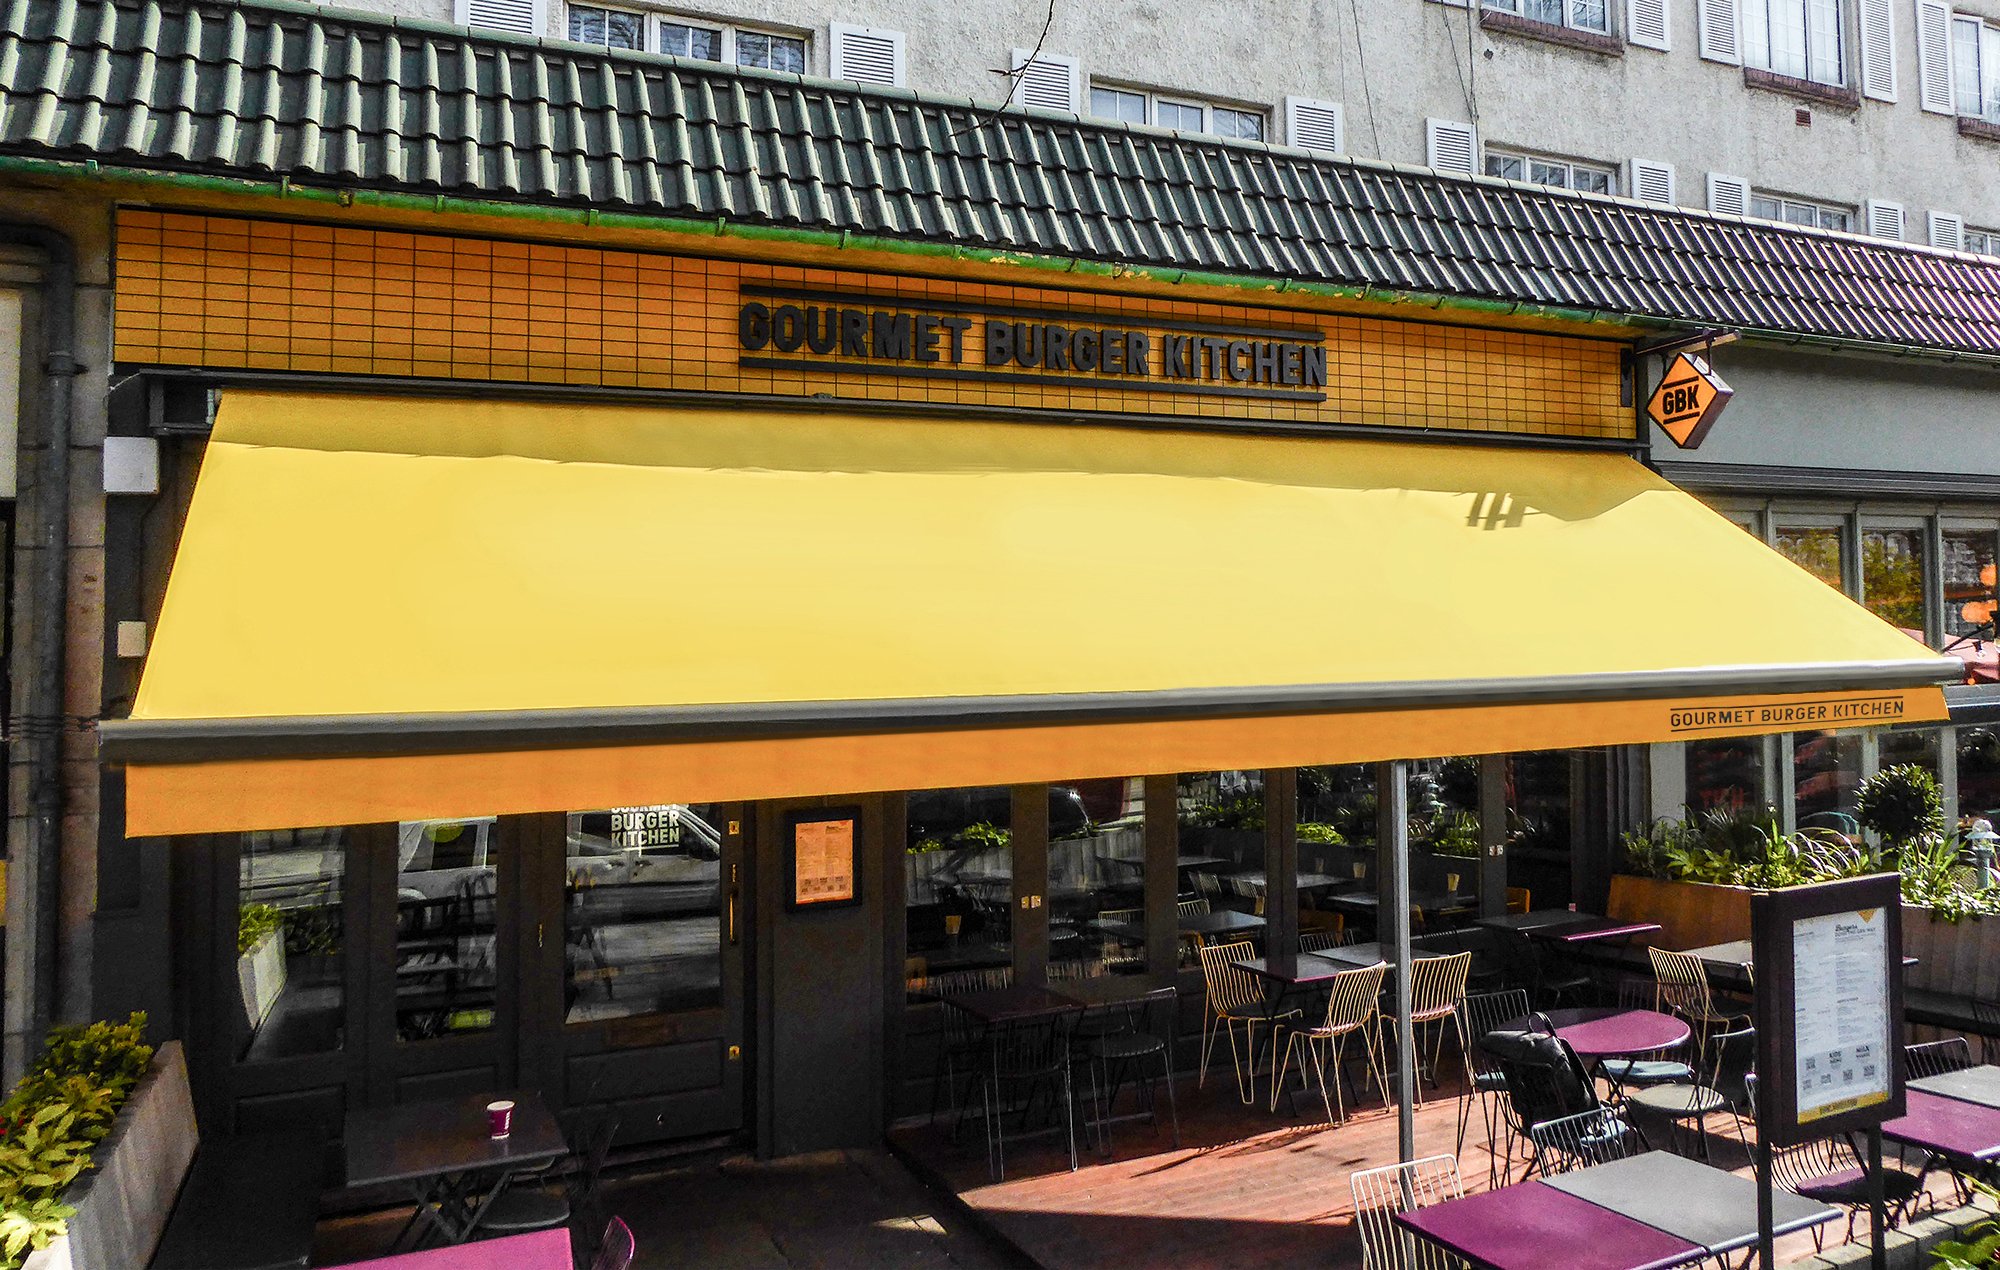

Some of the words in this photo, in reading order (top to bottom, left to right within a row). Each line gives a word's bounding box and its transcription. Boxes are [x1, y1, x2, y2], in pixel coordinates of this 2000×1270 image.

[739, 302, 972, 364] GOURMET
[984, 320, 1151, 376] BURGER
[1164, 334, 1327, 387] KITCHEN
[1662, 384, 1700, 415] GBK
[1670, 710, 1755, 727] GOURMET
[1761, 705, 1827, 722] BURGER
[1833, 701, 1904, 718] KITCHEN
[611, 810, 680, 831] BURGER
[611, 828, 680, 847] KITCHEN
